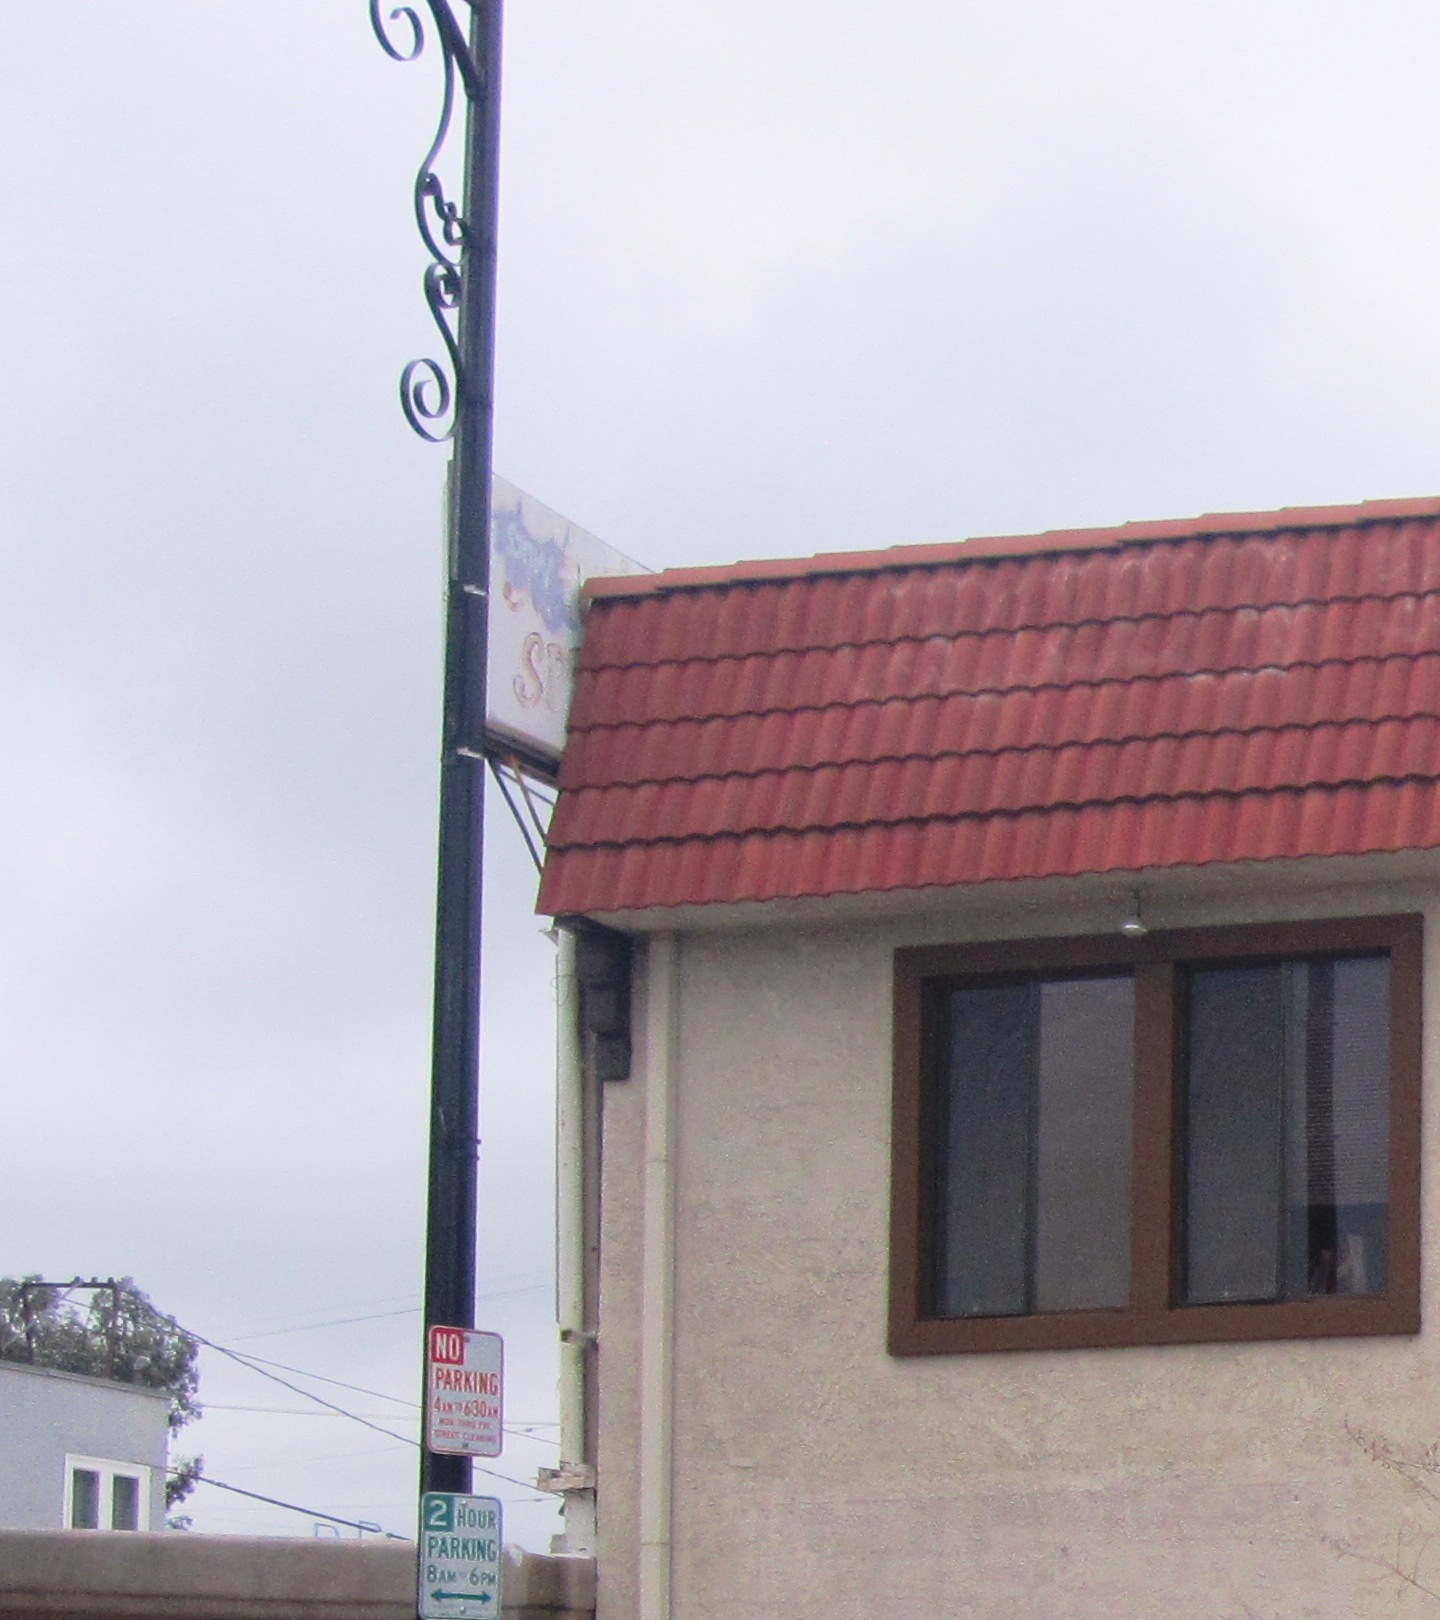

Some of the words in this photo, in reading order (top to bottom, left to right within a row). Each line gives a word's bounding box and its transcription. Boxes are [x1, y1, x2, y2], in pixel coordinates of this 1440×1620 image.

[436, 1333, 460, 1361] NO
[436, 1367, 498, 1395] PARKING
[429, 1499, 448, 1526] 2
[457, 1508, 496, 1529] HOUR
[428, 1536, 497, 1562] PARKING
[426, 1564, 456, 1583] 8AM
[469, 1567, 496, 1586] 6PM
